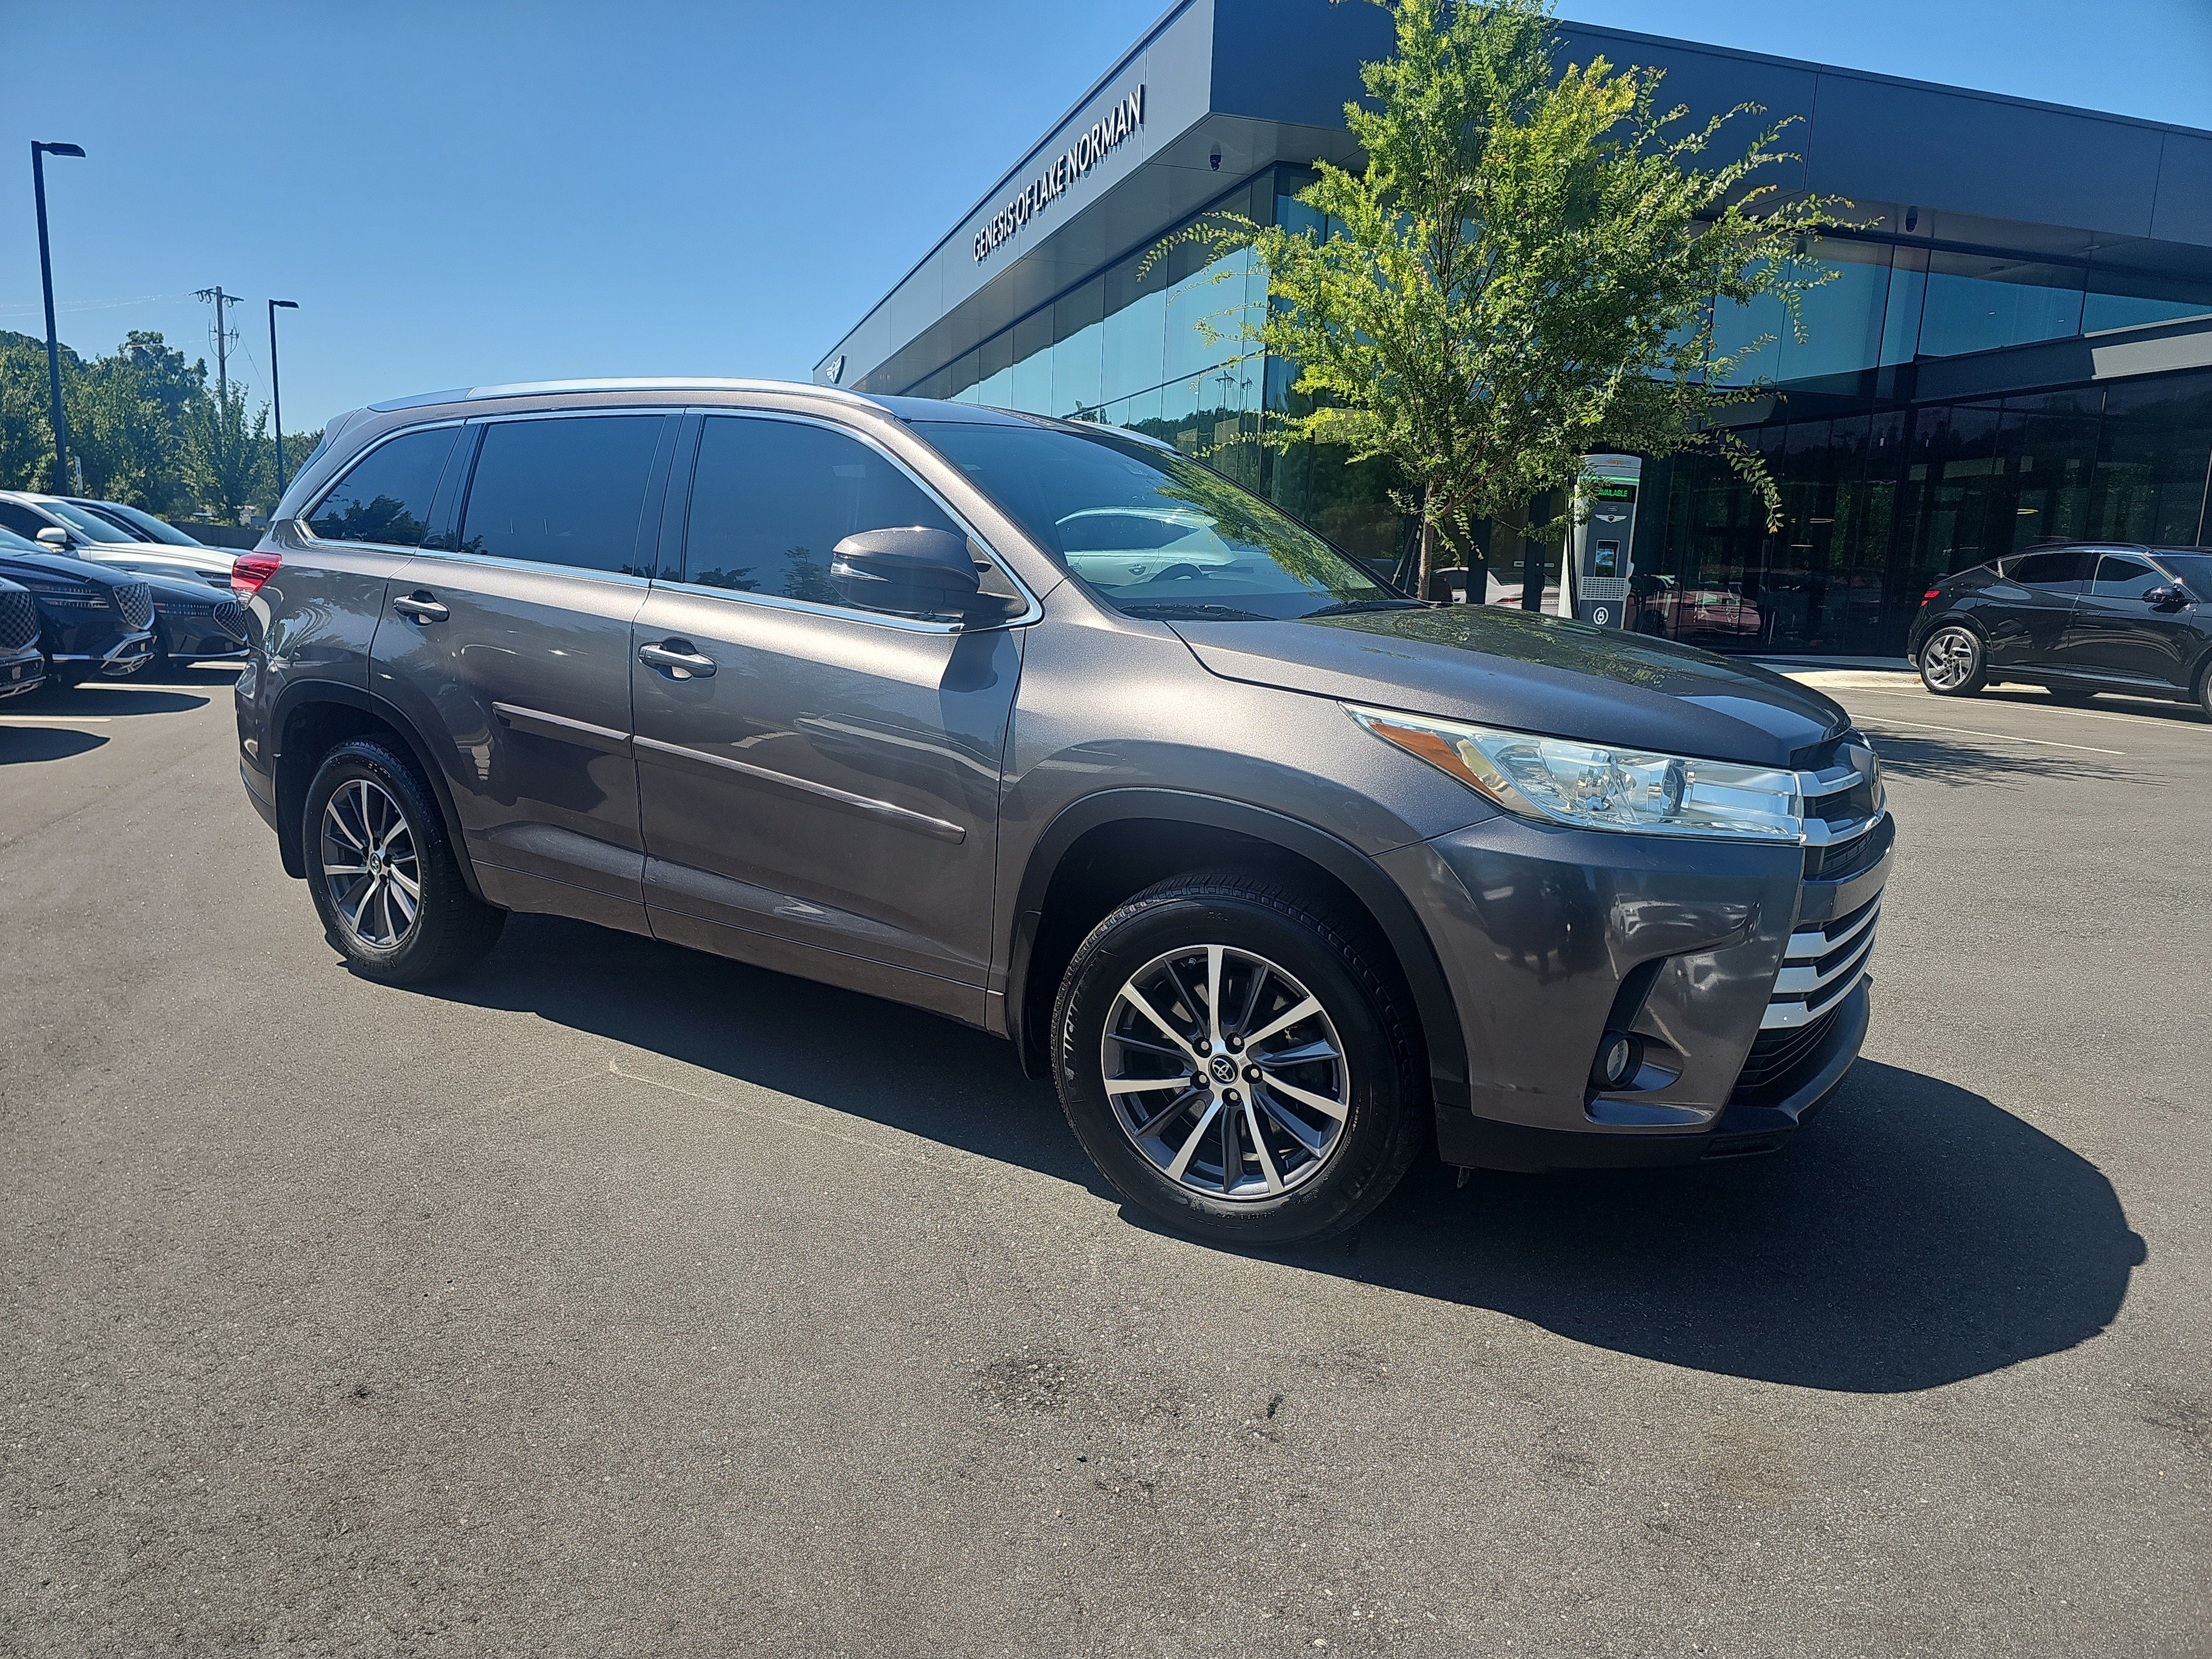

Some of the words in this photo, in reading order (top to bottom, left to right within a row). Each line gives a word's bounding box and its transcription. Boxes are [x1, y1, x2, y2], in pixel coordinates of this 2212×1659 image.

[973, 201, 1015, 262] GENESIS
[1016, 184, 1034, 225] OF
[1034, 154, 1066, 211] LAKE
[1068, 83, 1144, 183] NORMAN
